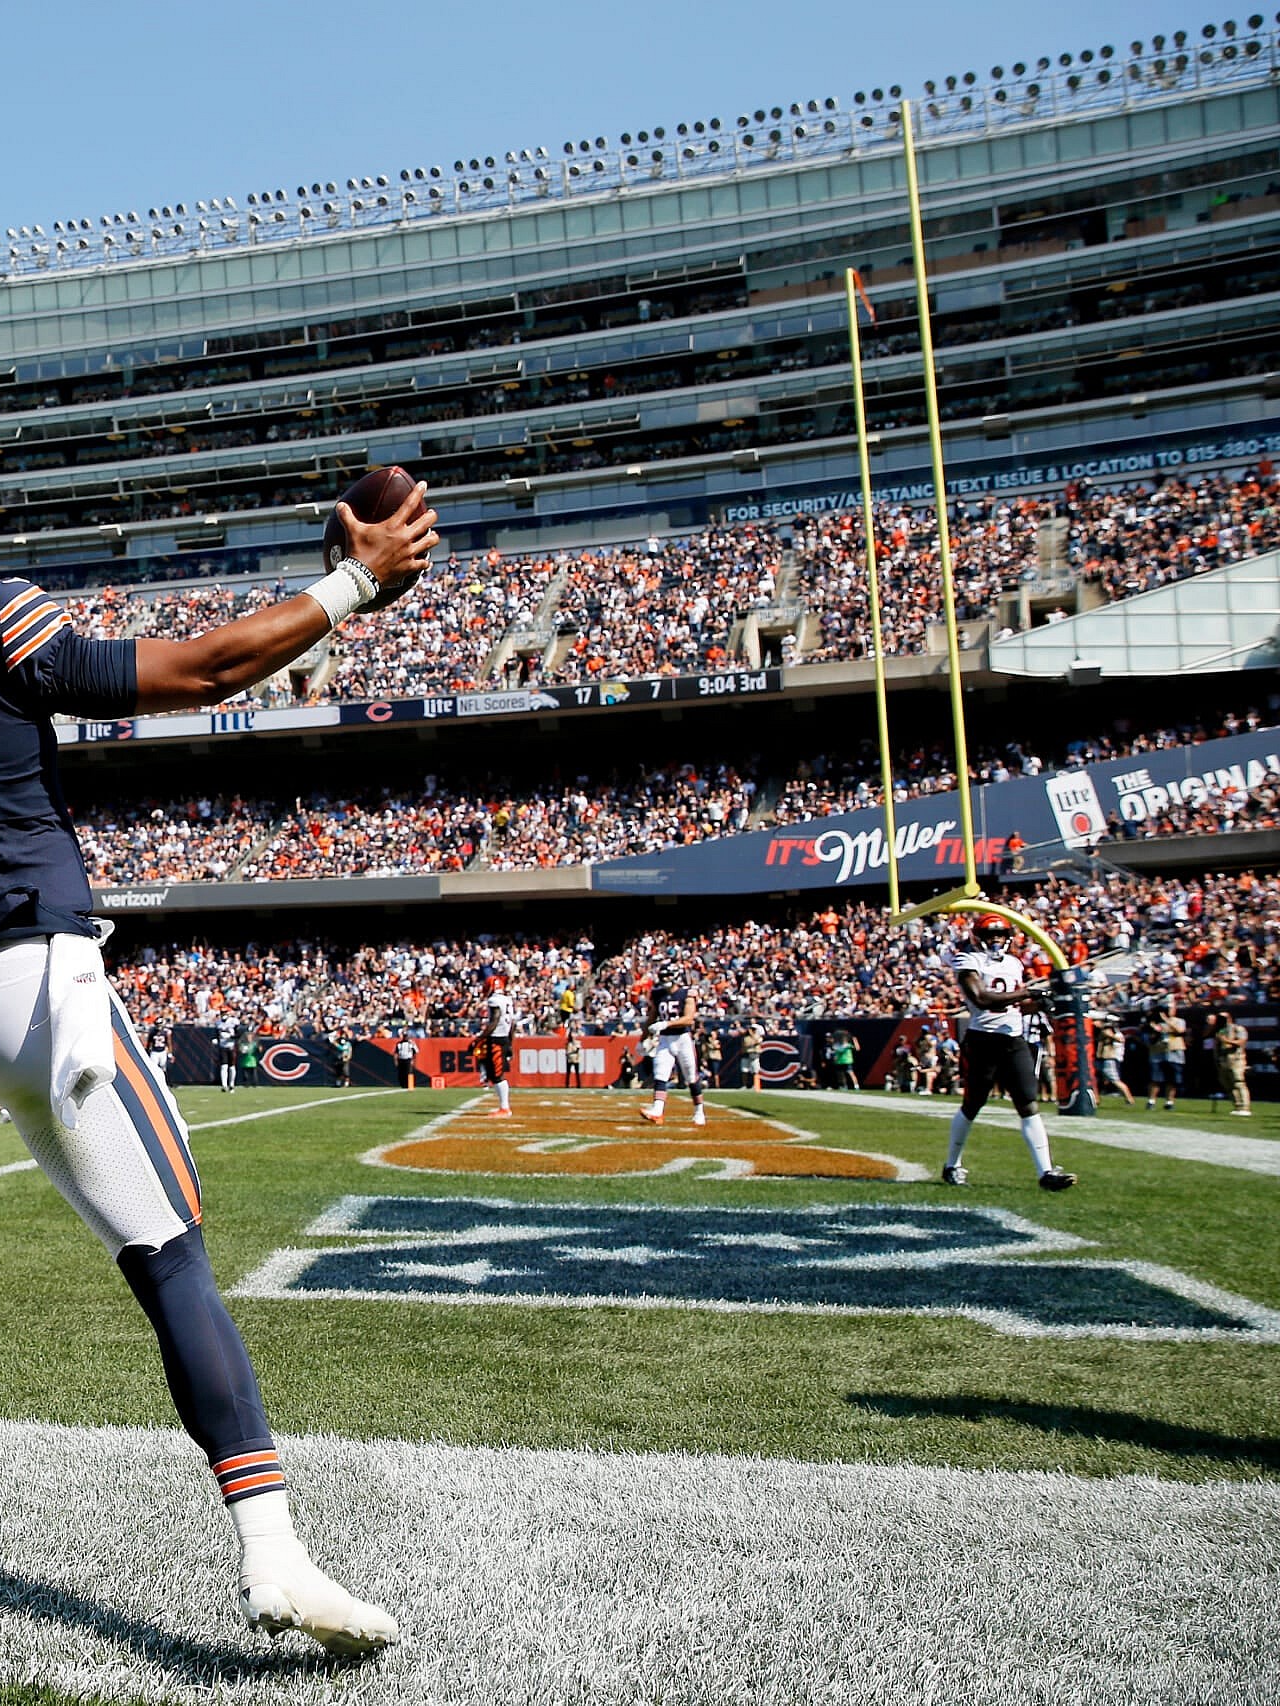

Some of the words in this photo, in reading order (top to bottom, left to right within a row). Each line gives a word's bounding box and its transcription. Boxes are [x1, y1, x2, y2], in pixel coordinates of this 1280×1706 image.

[727, 506, 759, 521] FOR
[762, 484, 935, 517] SECURITY/ASSISTANC
[948, 475, 990, 494] TEXT
[994, 469, 1043, 489] ISSUE
[1047, 467, 1058, 483] &
[1062, 453, 1154, 481] LOCATION
[1157, 451, 1183, 466] TO
[651, 681, 661, 699] 7
[699, 674, 736, 695] 9:04
[740, 672, 767, 692] 3rd
[460, 699, 480, 713] NFL
[484, 696, 525, 711] Scores
[574, 687, 593, 705] 17
[423, 699, 453, 718] Lite
[85, 723, 112, 741] Lite
[1111, 769, 1152, 792] THE
[1055, 788, 1090, 812] Lite
[765, 839, 823, 866] IT'S
[814, 820, 957, 884] Miller
[101, 890, 162, 907] verizon
[659, 1001, 680, 1021] 85
[440, 1050, 511, 1073] BE
